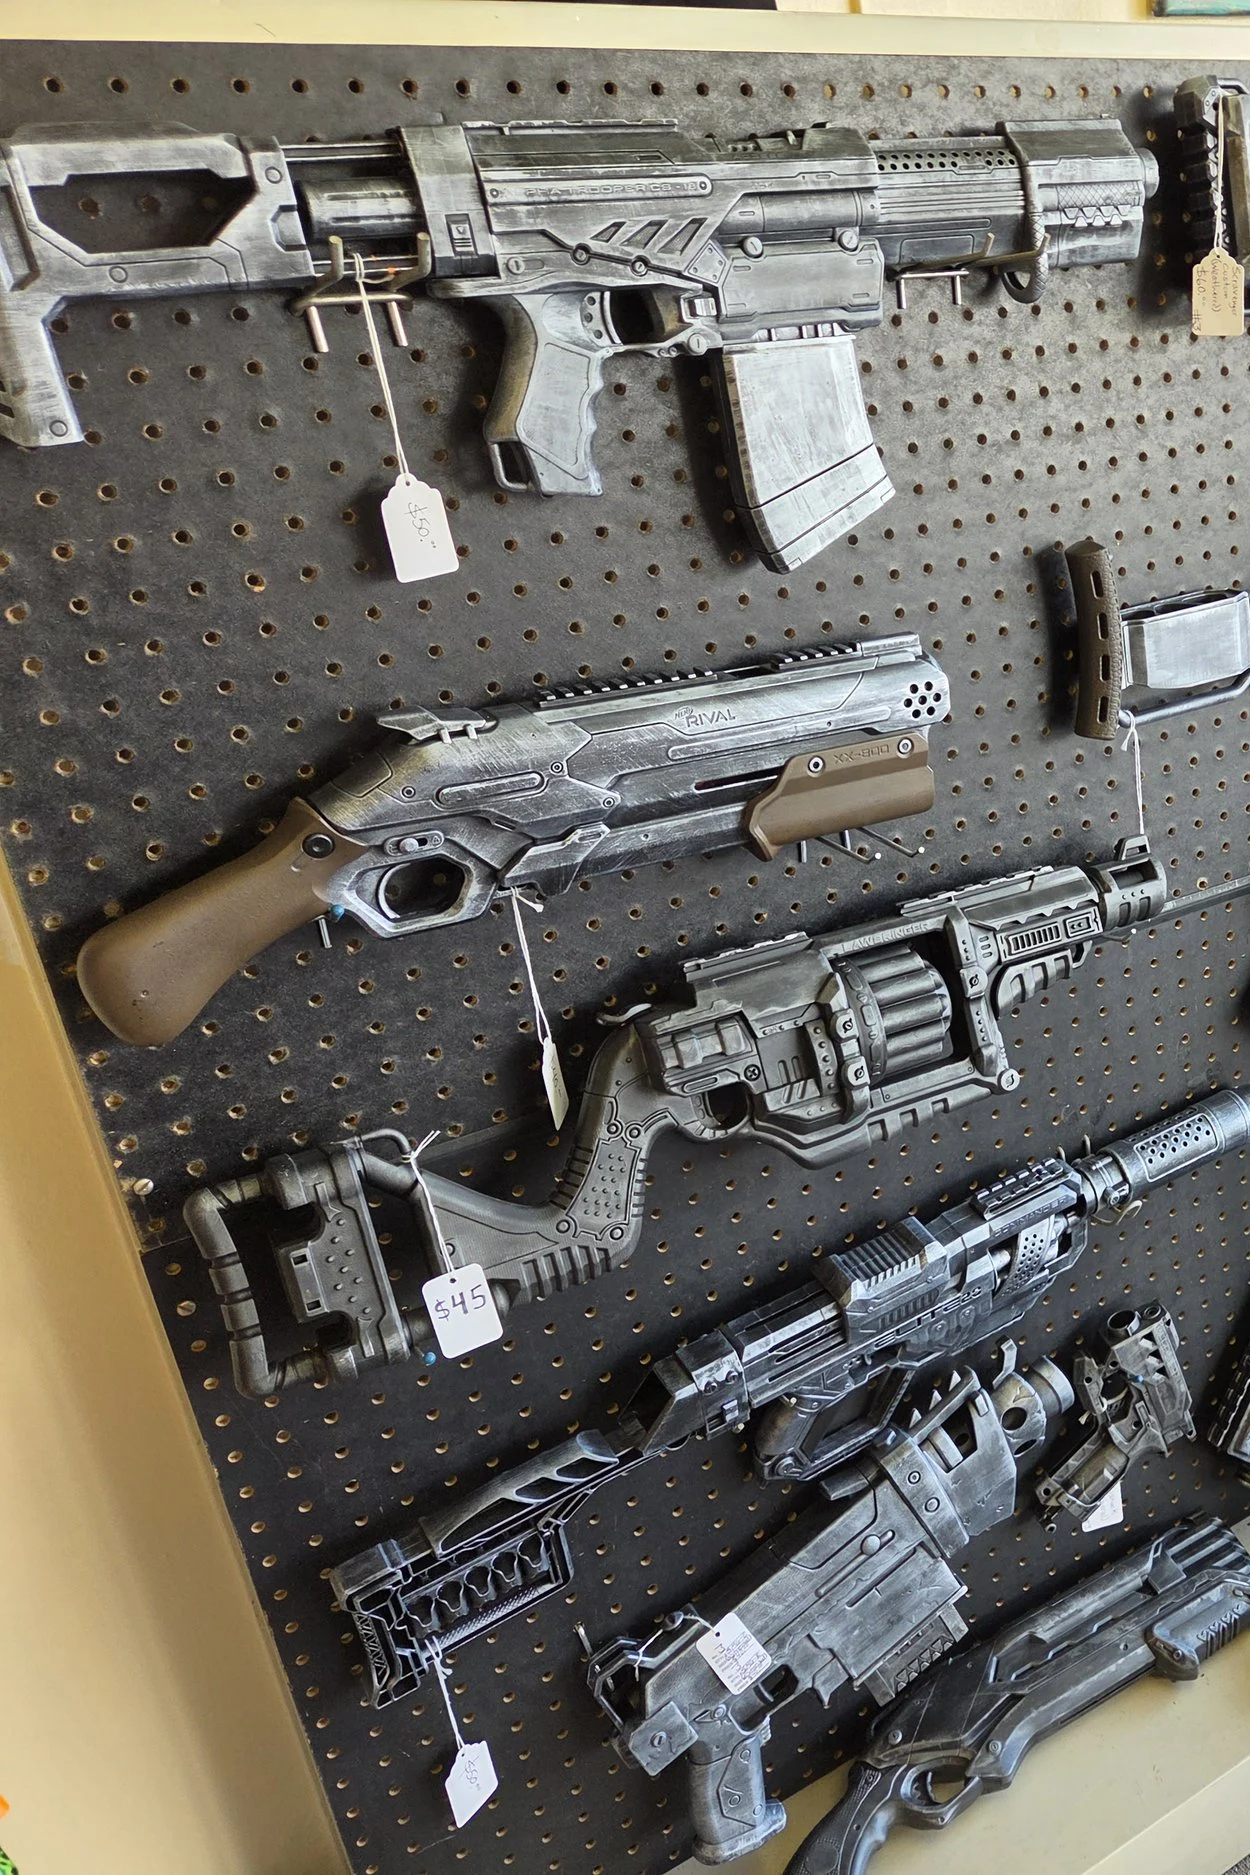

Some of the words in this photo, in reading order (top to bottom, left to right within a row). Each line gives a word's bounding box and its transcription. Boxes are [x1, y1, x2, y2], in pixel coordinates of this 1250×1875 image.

[686, 708, 737, 729] RIVAL
[833, 743, 891, 765] XX-800
[434, 1284, 487, 1322] $45
[873, 1295, 962, 1349] ELITE
